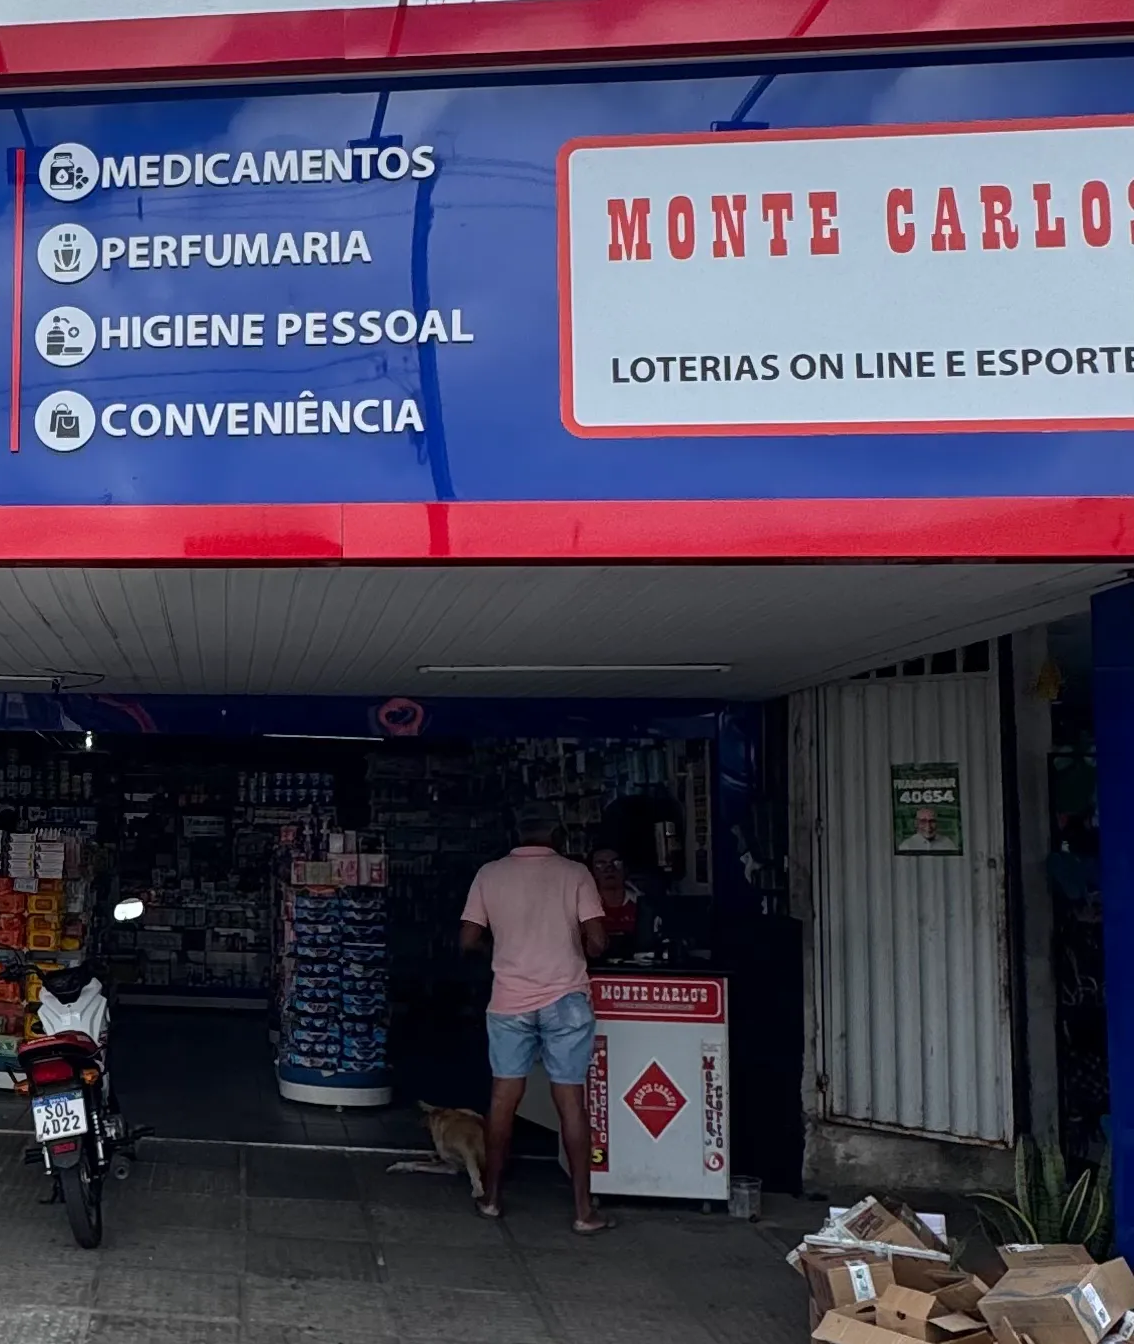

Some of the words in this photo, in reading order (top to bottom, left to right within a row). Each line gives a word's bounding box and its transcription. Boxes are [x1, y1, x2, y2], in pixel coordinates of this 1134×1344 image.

[102, 145, 435, 188] MEDICAMENTOS
[607, 190, 840, 262] MONTE
[886, 179, 1134, 254] CARLO
[102, 229, 372, 270] PERFUMARIA
[102, 313, 264, 351] HIGIENE
[278, 308, 475, 348] PESSOAL
[612, 353, 780, 385] LOTERIAS
[790, 353, 845, 381] ON
[855, 350, 935, 380] LINE
[946, 350, 966, 377] E
[101, 390, 425, 440] CONVENIÊNCIA
[899, 789, 955, 804] 40654
[600, 985, 649, 1001] MONTE
[43, 1115, 81, 1135] 4D22
[44, 1101, 74, 1120] SOL
